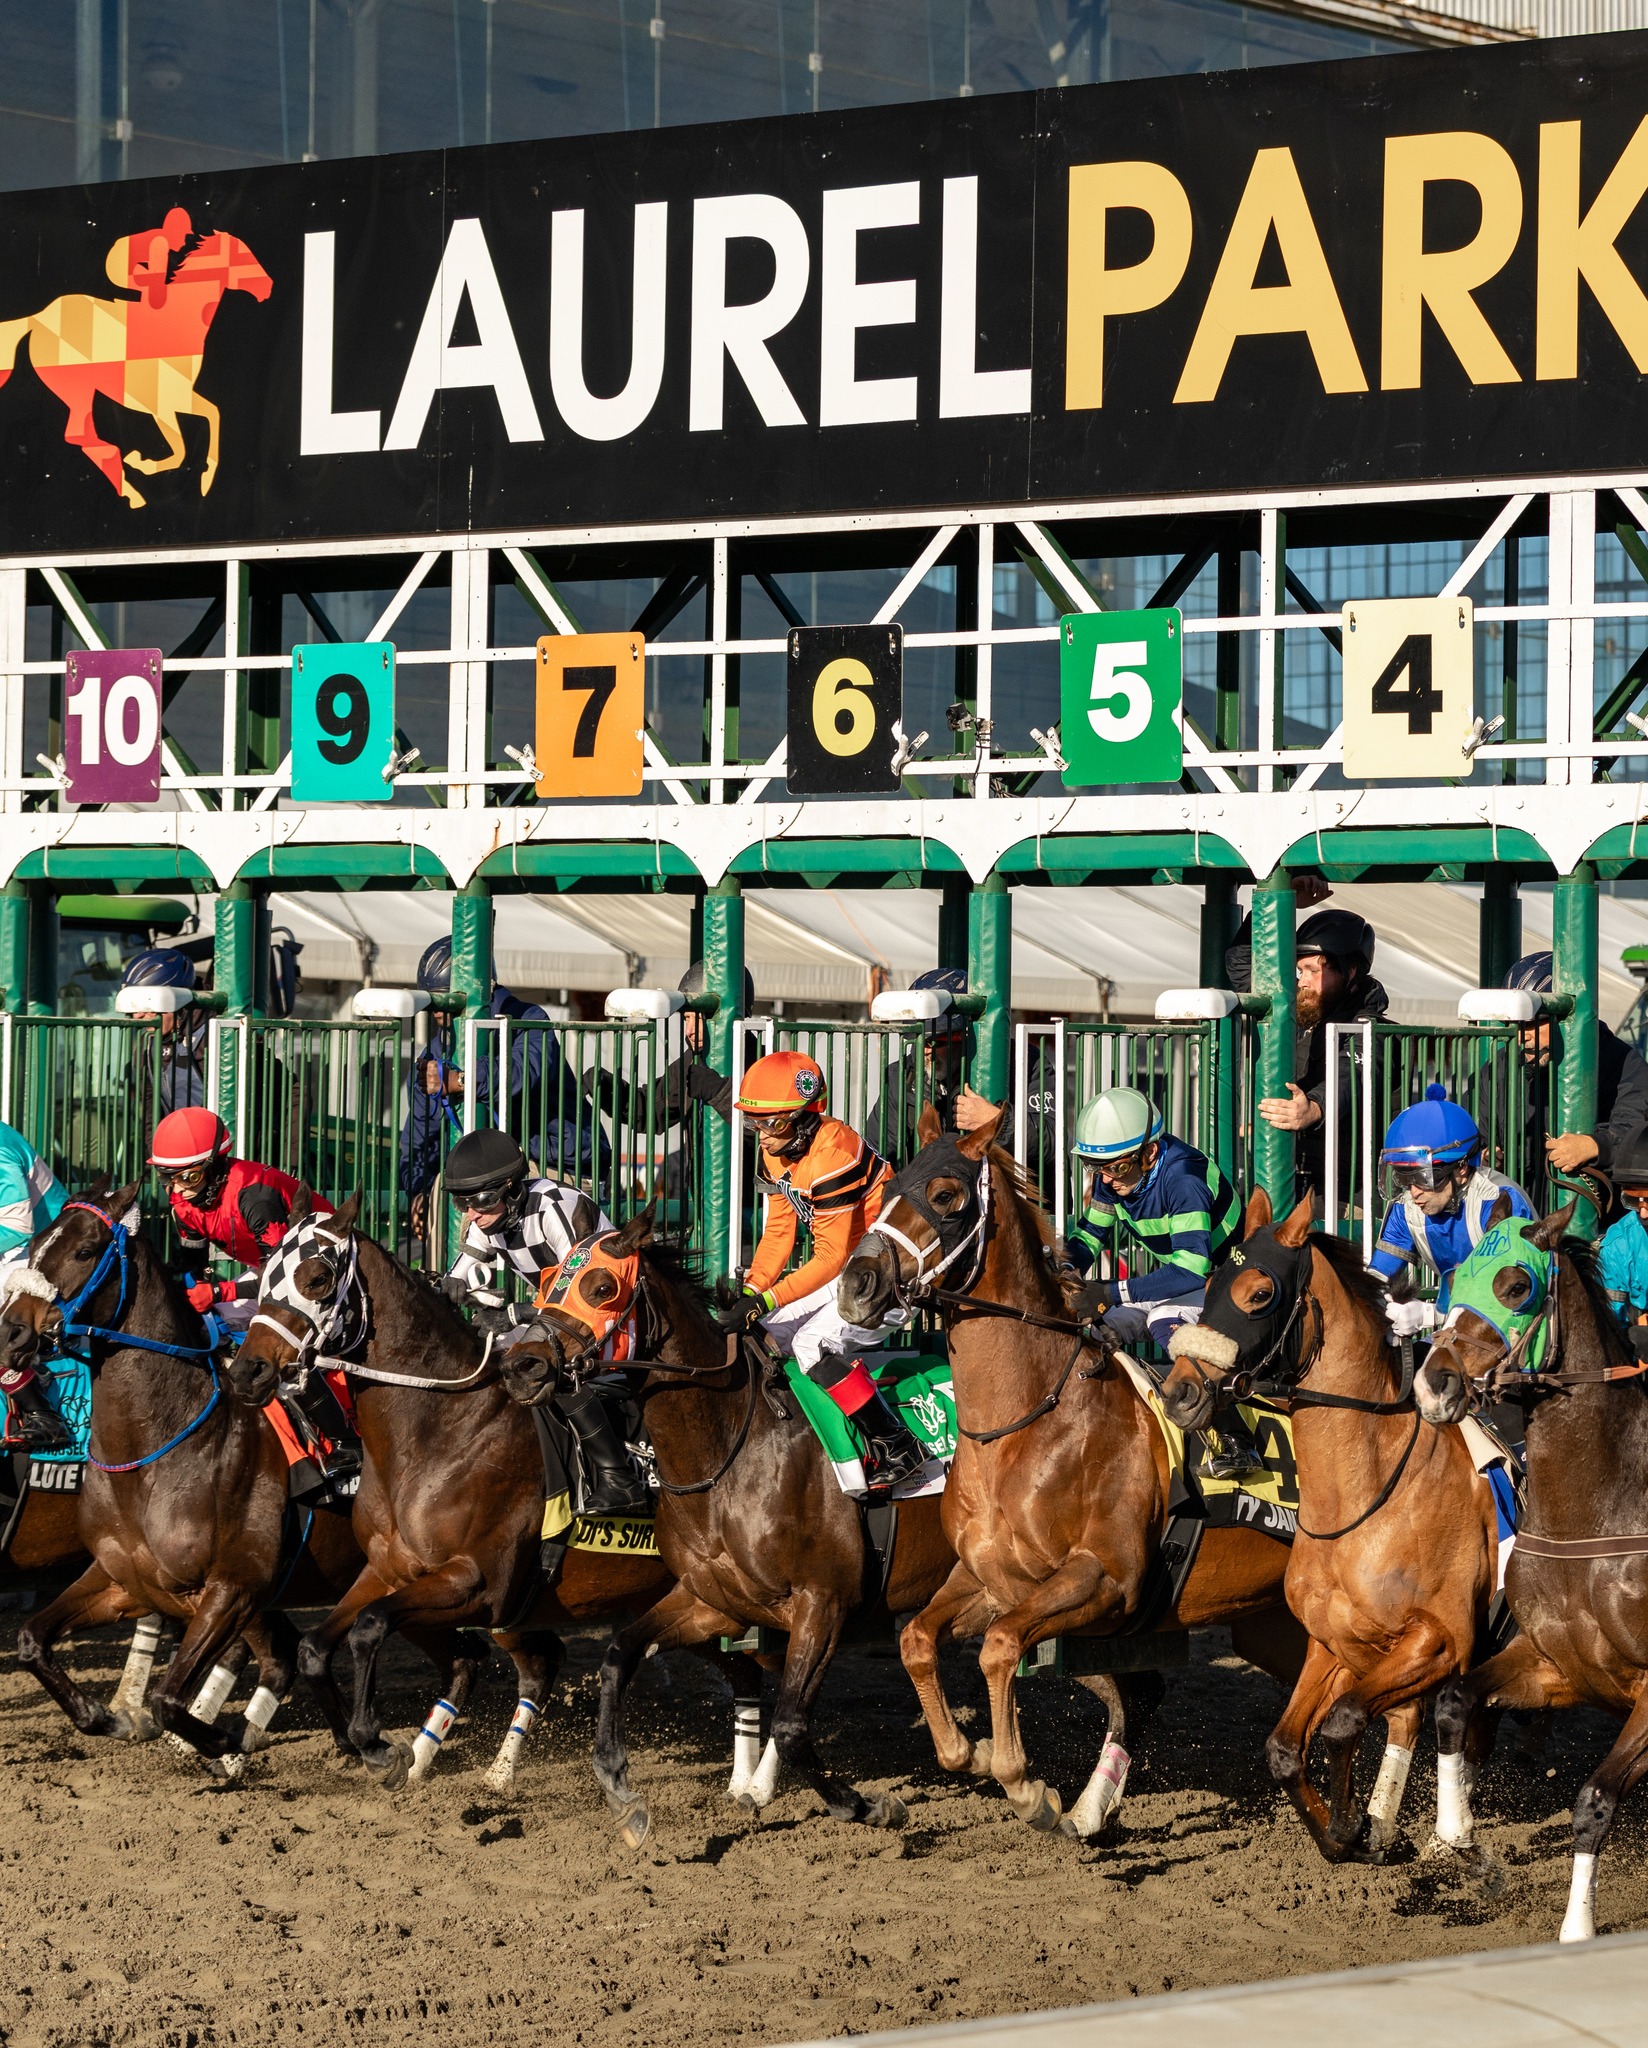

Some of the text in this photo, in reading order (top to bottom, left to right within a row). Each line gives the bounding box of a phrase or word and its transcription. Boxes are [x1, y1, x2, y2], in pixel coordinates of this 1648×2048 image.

[300, 114, 1648, 457] LAUREL PARK
[67, 674, 159, 767] 10
[315, 672, 371, 765] 9
[562, 665, 617, 758] 7
[811, 657, 876, 757] 6
[1087, 640, 1153, 743] 5
[1371, 633, 1444, 735] 4
[29, 1462, 80, 1490] LUTE
